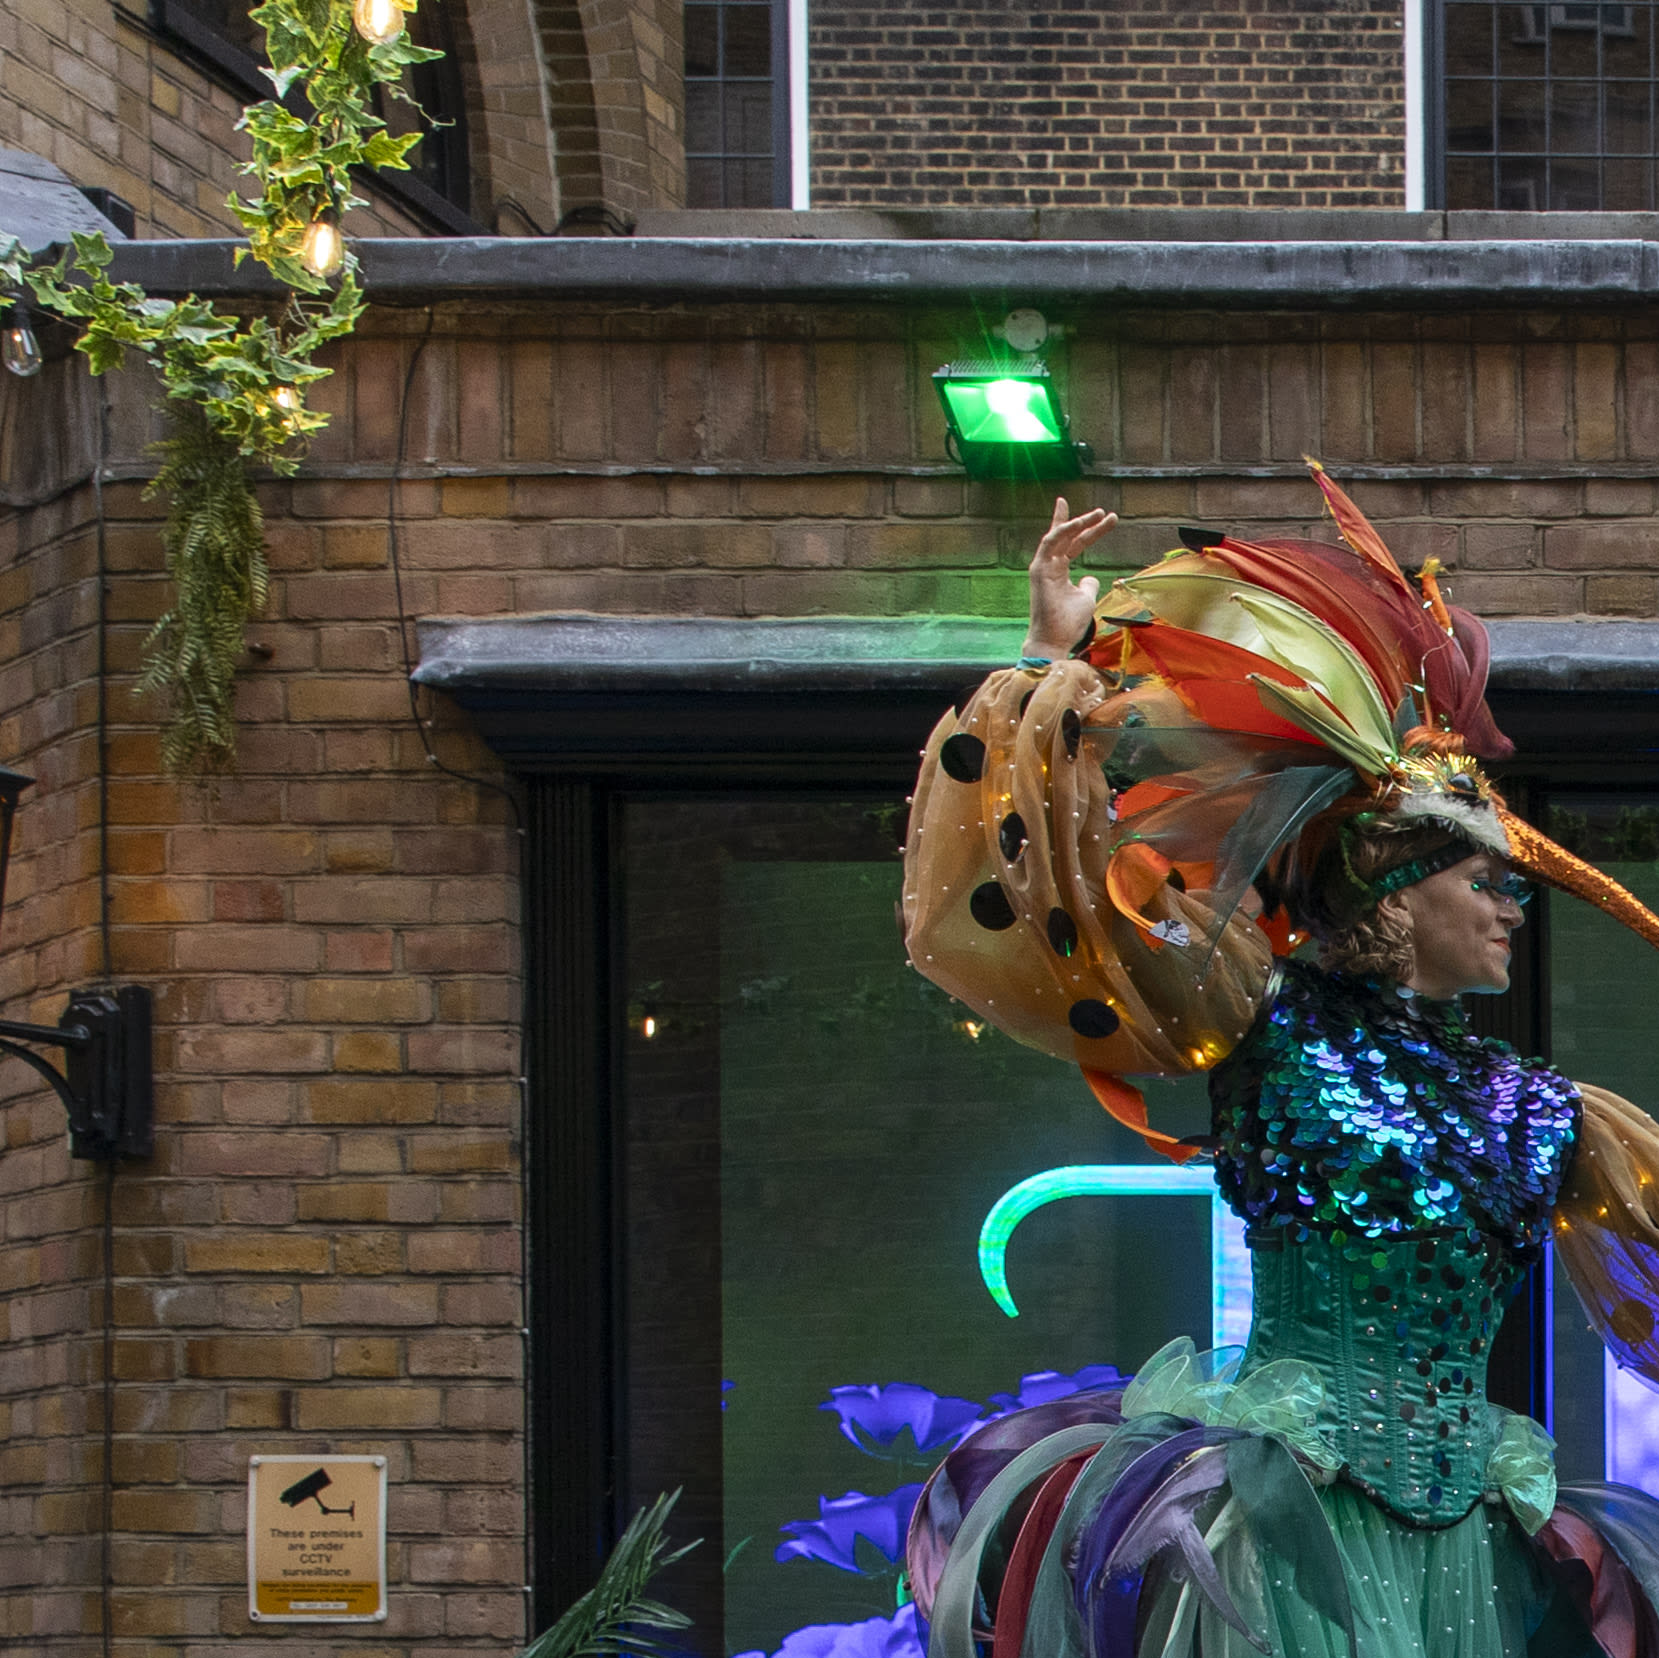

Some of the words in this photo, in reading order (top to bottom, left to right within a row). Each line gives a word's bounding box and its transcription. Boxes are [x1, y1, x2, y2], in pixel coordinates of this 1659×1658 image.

[270, 1528, 305, 1539] These
[310, 1529, 363, 1541] premises
[288, 1542, 306, 1551] are
[311, 1541, 344, 1551] under
[299, 1553, 333, 1564] CCTV
[282, 1566, 351, 1577] surveillance
